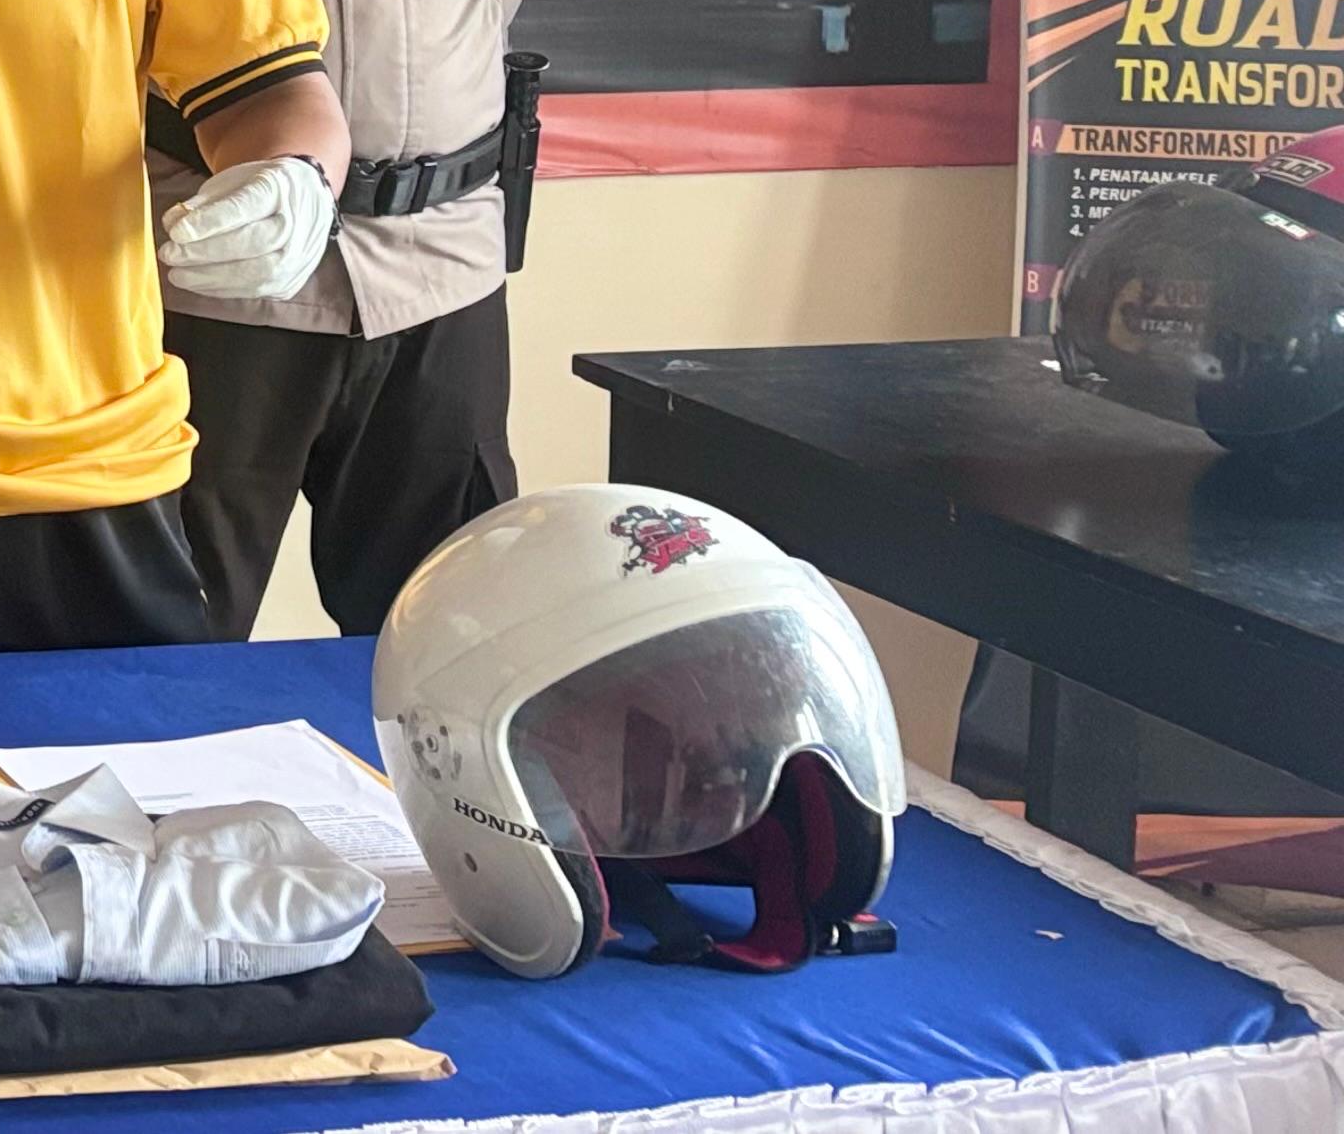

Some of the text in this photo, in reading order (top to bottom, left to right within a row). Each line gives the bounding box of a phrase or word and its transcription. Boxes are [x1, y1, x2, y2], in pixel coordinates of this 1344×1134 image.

[1031, 128, 1044, 149] A
[1070, 127, 1256, 158] TRANSFORMASI
[1073, 167, 1086, 182] 1.
[1089, 168, 1172, 183] PENATAAN
[1071, 186, 1084, 200] 2.
[1070, 205, 1084, 219] 3.
[1069, 224, 1084, 239] 4.
[1027, 270, 1039, 293] B
[453, 796, 552, 847] HONDA
